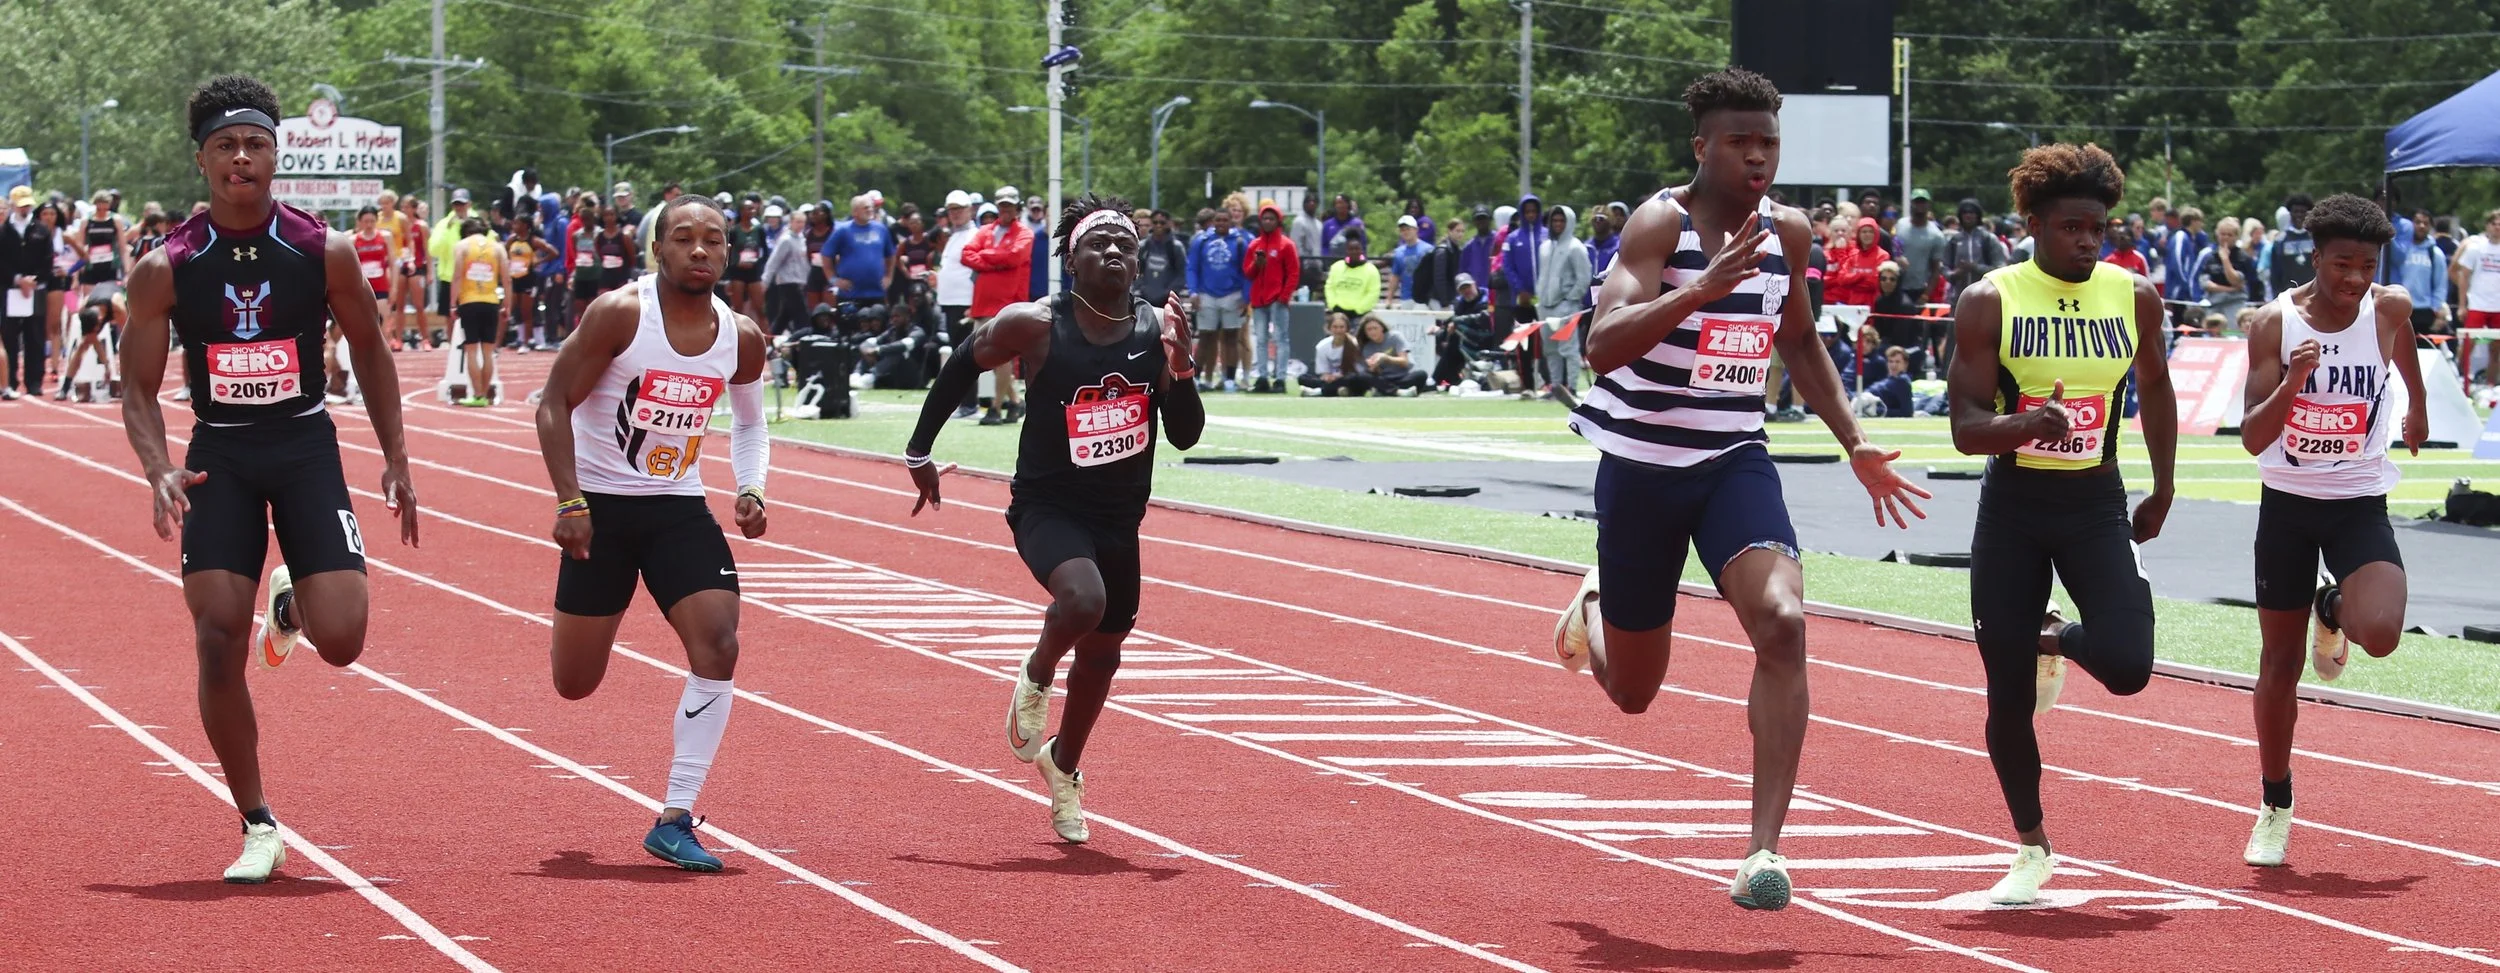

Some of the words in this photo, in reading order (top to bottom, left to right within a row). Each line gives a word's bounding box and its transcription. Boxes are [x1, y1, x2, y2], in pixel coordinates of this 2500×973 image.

[287, 131, 332, 148] Robert
[355, 130, 397, 152] Hyder
[335, 154, 397, 171] ARENA
[1727, 323, 1760, 333] SHOW-ME
[2010, 316, 2133, 359] NORTHTOWN
[231, 344, 271, 354] SHOW-ME
[1707, 329, 1769, 354] ZERO
[216, 349, 289, 372] ZERO
[668, 374, 703, 386] SHOW-ME
[1713, 363, 1757, 385] 2400
[2327, 365, 2377, 401] PARK
[230, 381, 279, 398] 2067
[648, 379, 713, 404] ZERO
[1091, 400, 1129, 413] SHOW-ME
[2026, 404, 2097, 427] RO
[2307, 404, 2344, 414] SHOW-ME
[652, 409, 694, 429] 2114
[1075, 404, 1142, 433] ZERO
[2290, 406, 2358, 430] ZERO
[1091, 434, 1135, 459] 2330
[2034, 437, 2084, 453] 2286
[2298, 437, 2344, 454] 2289
[346, 513, 362, 553] 8
